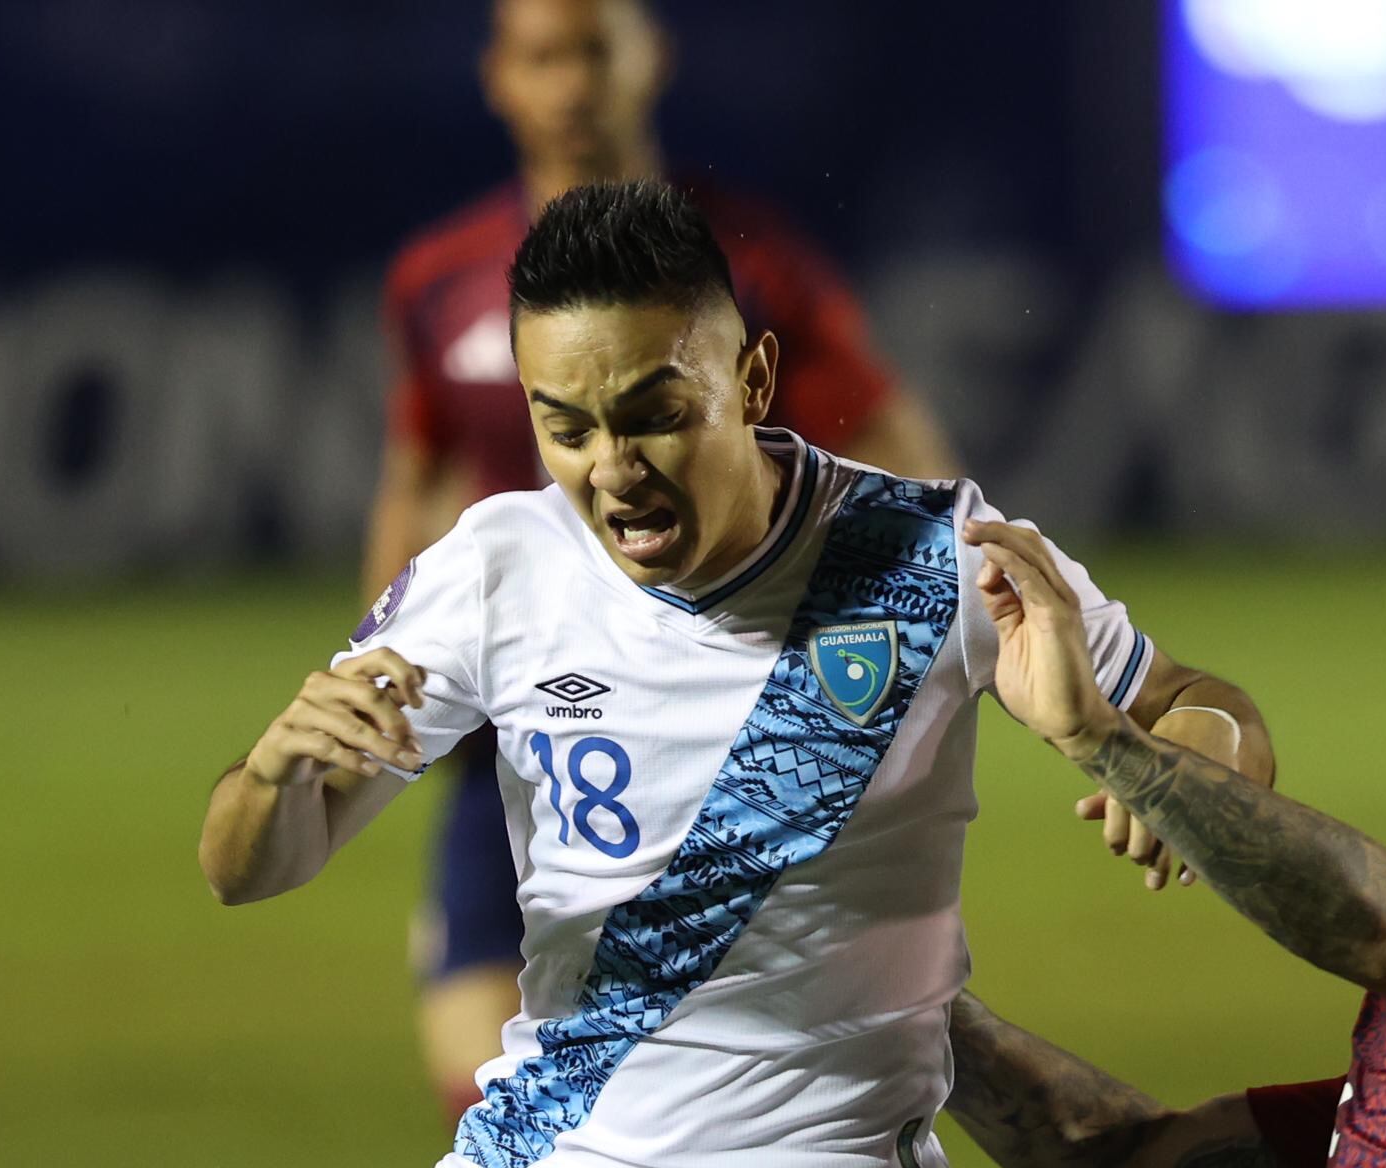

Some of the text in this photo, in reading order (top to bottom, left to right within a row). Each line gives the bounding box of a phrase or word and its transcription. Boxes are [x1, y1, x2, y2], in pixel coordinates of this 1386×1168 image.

[819, 631, 886, 647] GUATEMALA
[545, 704, 603, 720] umbro
[529, 730, 641, 859] 18
